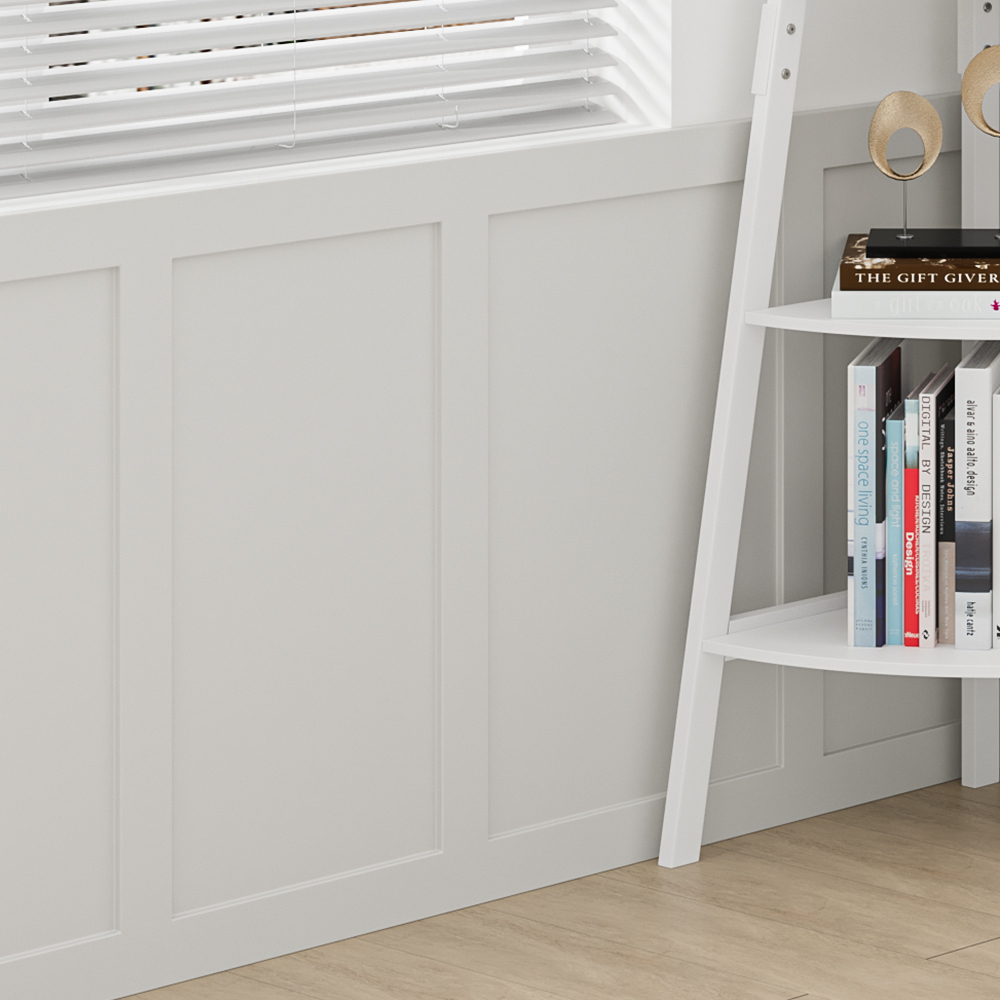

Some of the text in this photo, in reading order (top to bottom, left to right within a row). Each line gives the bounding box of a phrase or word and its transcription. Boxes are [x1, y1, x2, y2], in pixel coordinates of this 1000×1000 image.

[855, 272, 1000, 283] THE GIFT GIVER
[966, 400, 978, 420] alvar
[966, 428, 978, 445] aino
[854, 421, 873, 526] one space living
[887, 441, 901, 528] space and light
[921, 396, 931, 534] DIGITAL BY DESIGN
[945, 446, 955, 512] Jasper Johns
[964, 471, 978, 496] design
[860, 536, 868, 590] CYNTHIA INIONS
[904, 532, 915, 576] Design
[922, 542, 931, 591] TROIKA
[965, 601, 976, 636] hatje cantz
